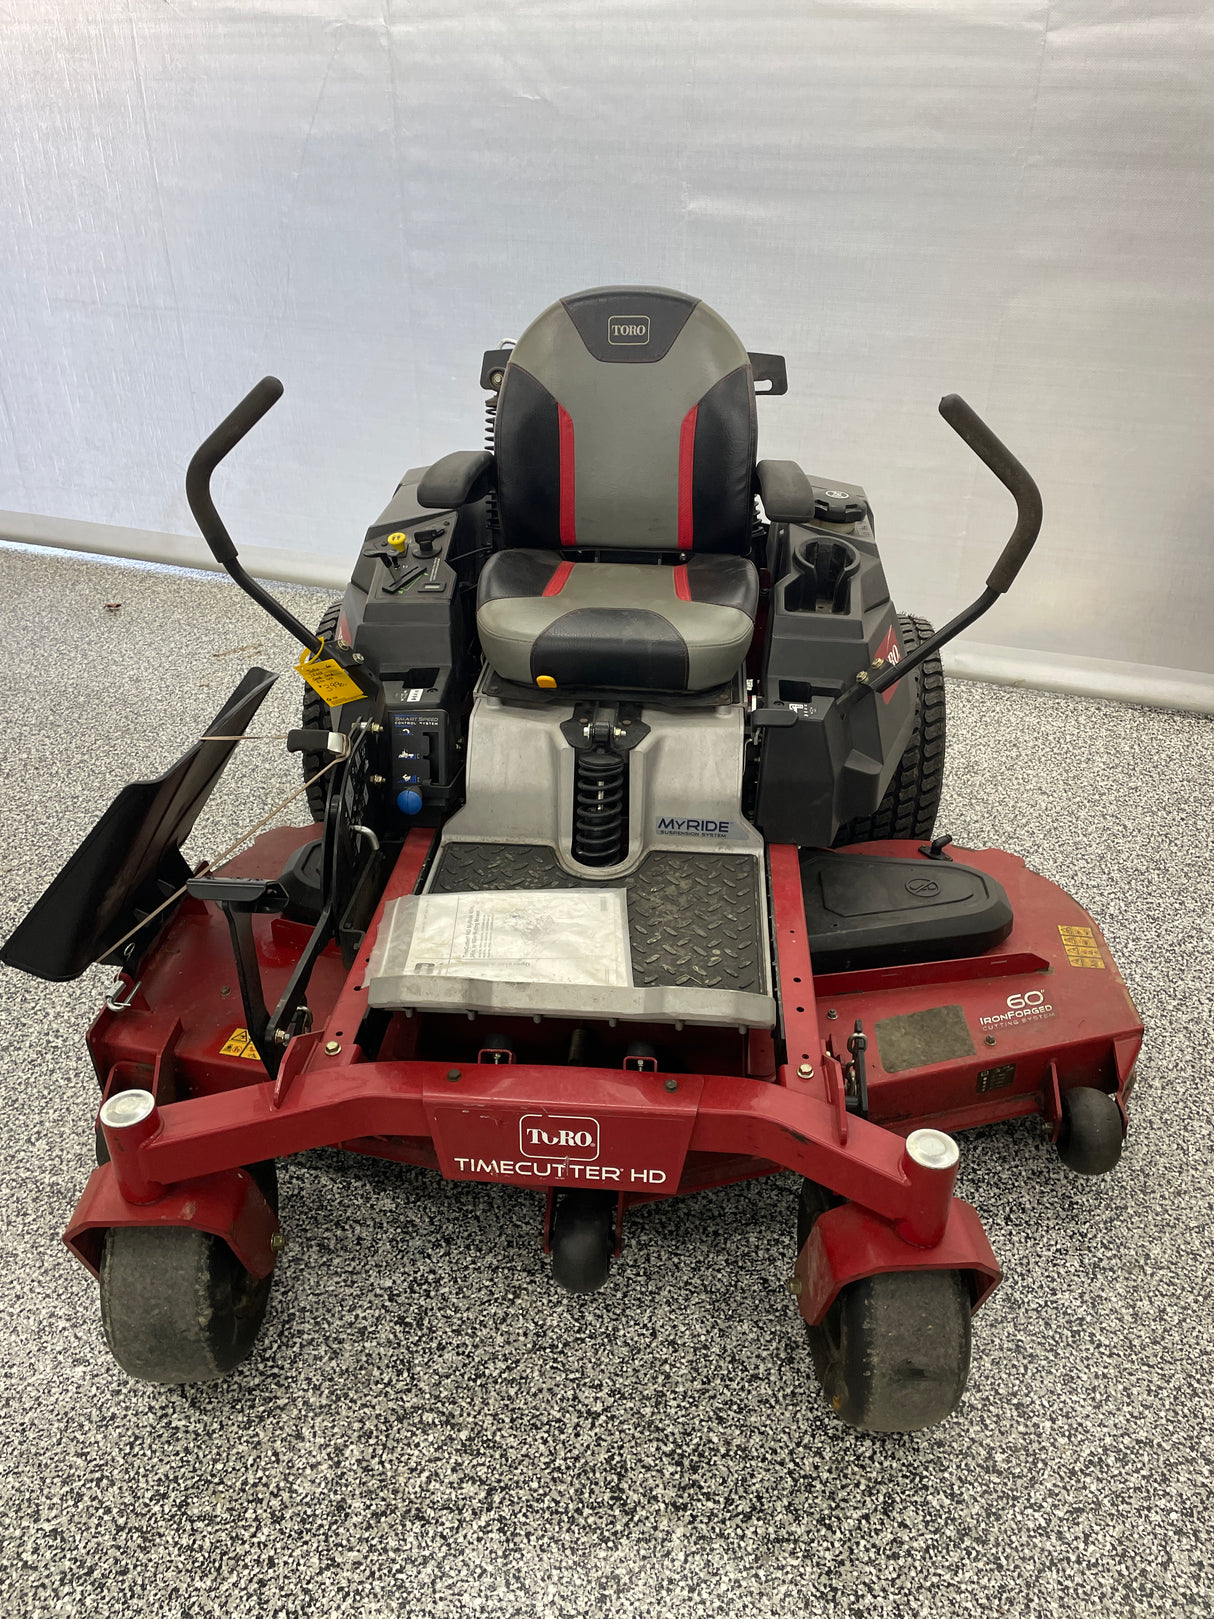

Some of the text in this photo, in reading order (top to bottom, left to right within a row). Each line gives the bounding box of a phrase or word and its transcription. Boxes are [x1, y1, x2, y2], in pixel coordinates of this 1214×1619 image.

[611, 324, 646, 336] TORO
[660, 829, 700, 838] SUSPENSION
[1006, 989, 1045, 1009] 60"
[982, 1012, 1056, 1032] CUTTING SYSTEM
[454, 1157, 667, 1184] TIMECUTTER HD
